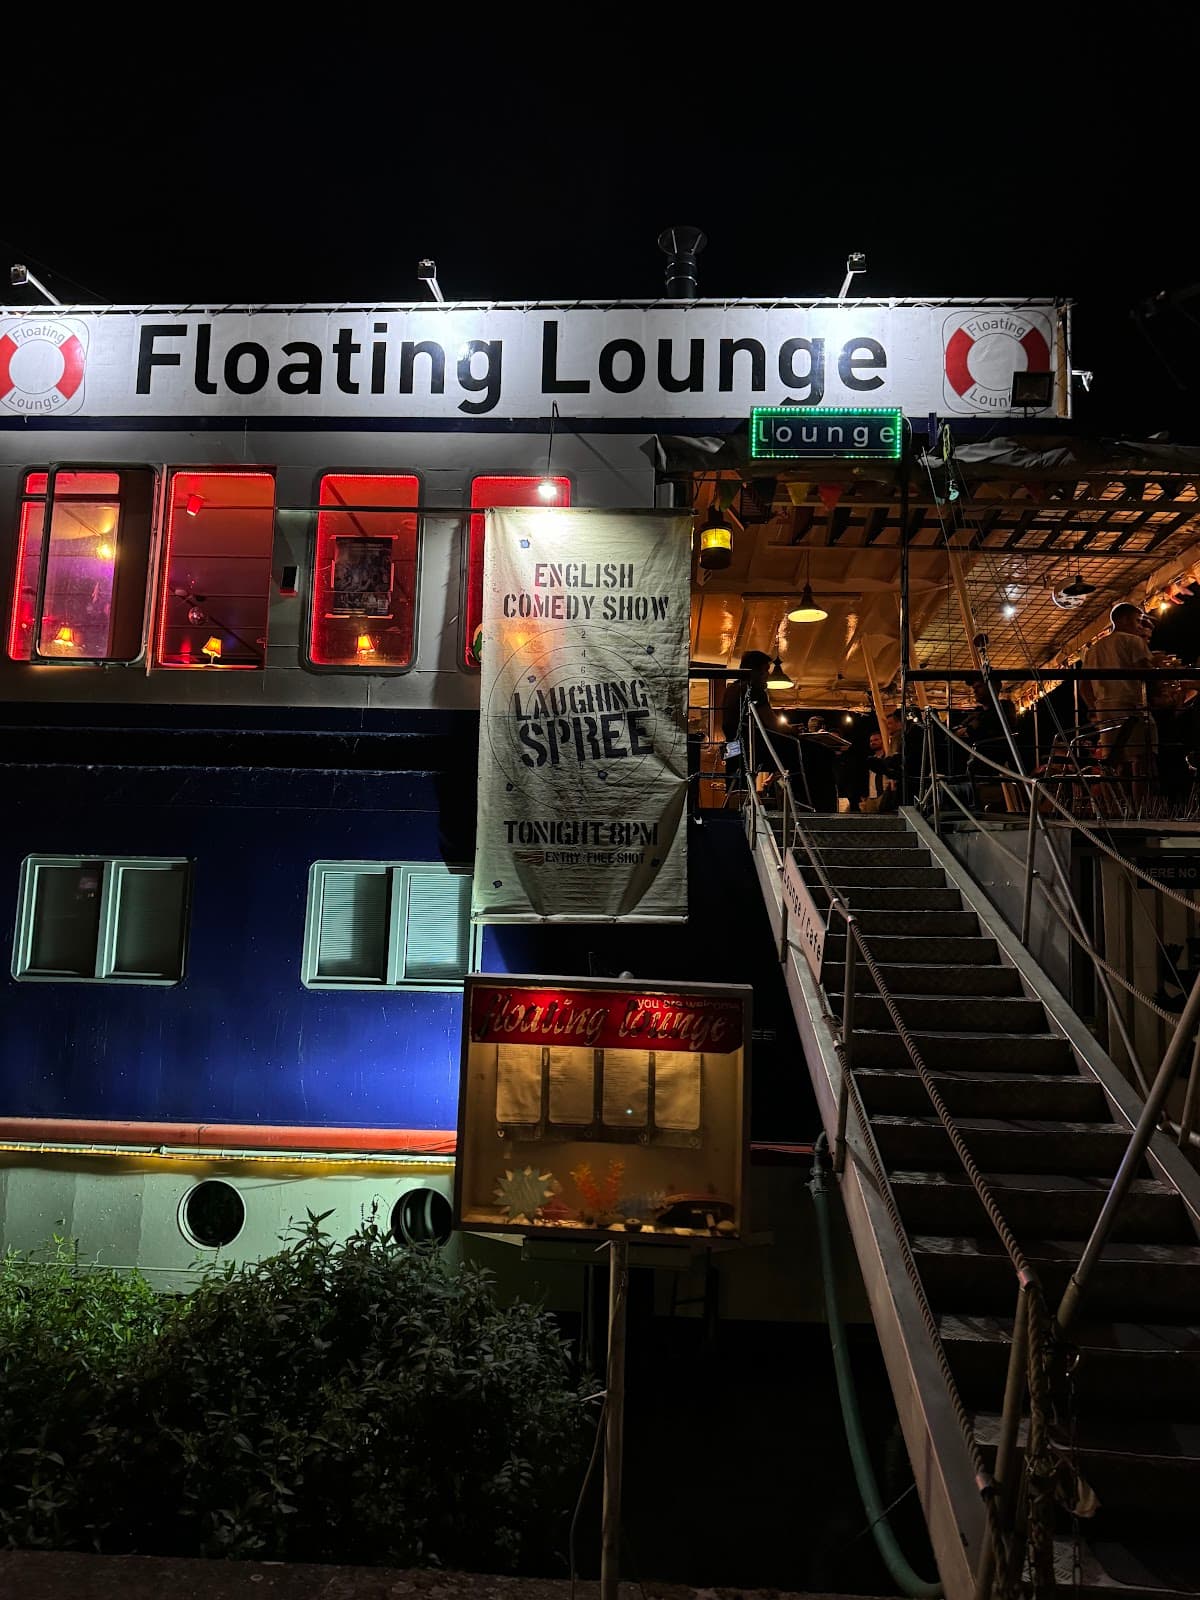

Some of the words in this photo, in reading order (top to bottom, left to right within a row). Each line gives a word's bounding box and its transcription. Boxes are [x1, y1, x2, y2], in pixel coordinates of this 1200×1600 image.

[13, 326, 66, 345] Floating
[967, 318, 1026, 338] Floating
[135, 322, 503, 415] Floating
[541, 320, 887, 406] Lounge
[9, 392, 60, 410] Lounge
[970, 388, 1009, 408] Loun
[759, 420, 895, 448] lounge
[535, 563, 634, 588] ENGLISH
[503, 594, 596, 620] COMEDY
[602, 595, 670, 621] SHOW
[514, 680, 649, 721] LAUGHING
[519, 710, 655, 767] SPREE
[504, 820, 603, 845] TONIGHT
[609, 821, 660, 847] 8PM
[545, 851, 581, 864] ENTRY
[587, 851, 616, 865] FREE
[616, 852, 646, 865] SHOT
[637, 998, 659, 1010] you
